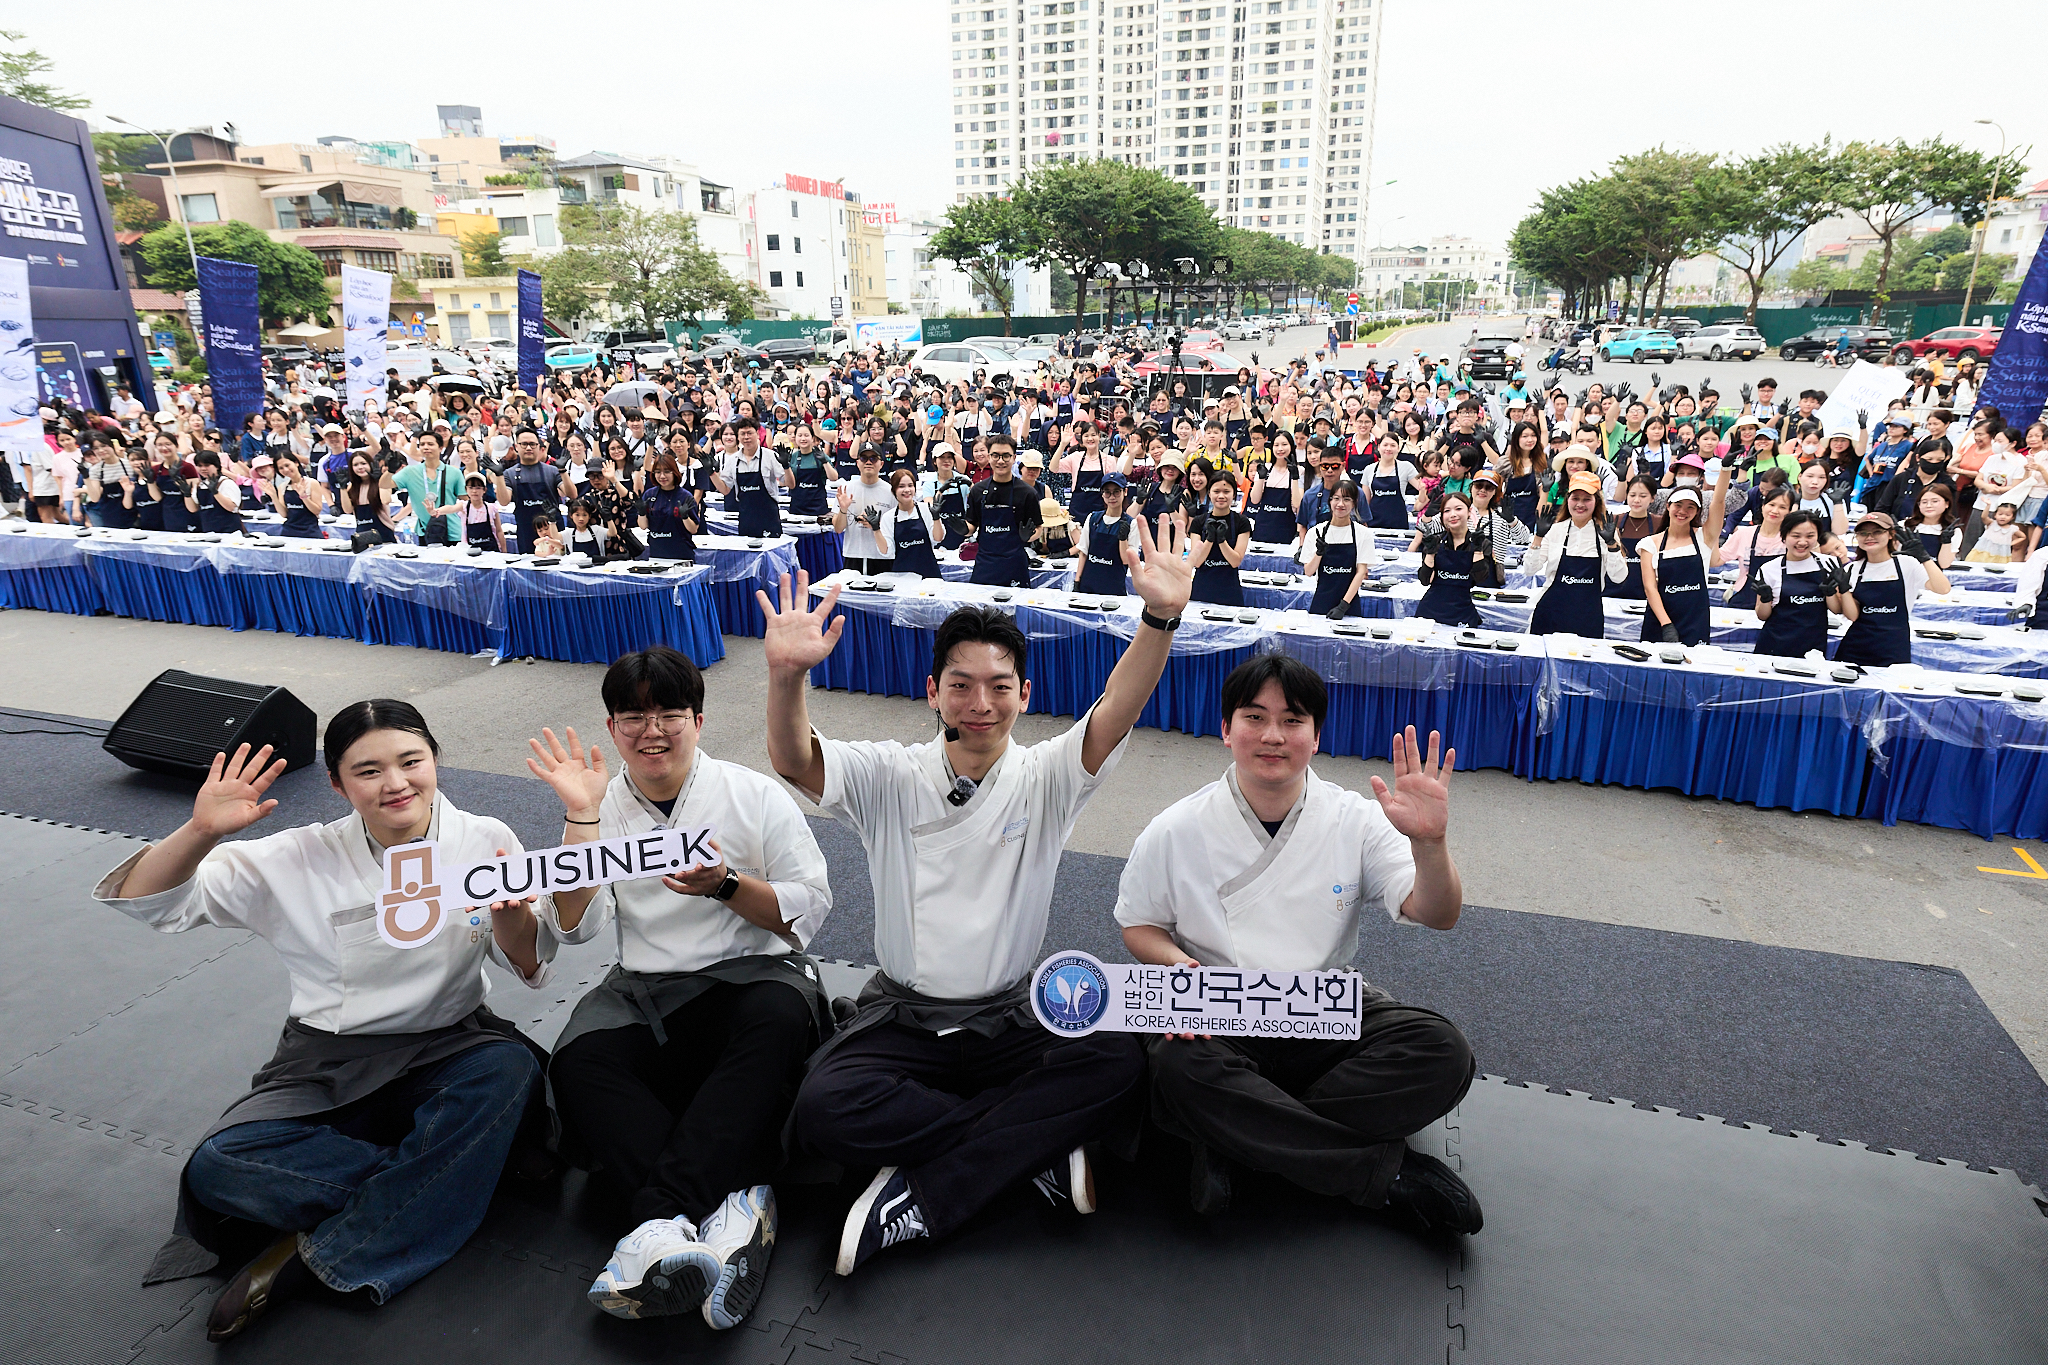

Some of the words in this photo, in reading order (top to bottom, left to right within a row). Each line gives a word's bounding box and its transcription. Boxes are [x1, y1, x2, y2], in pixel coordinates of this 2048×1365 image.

[785, 173, 818, 195] ROMEO
[820, 180, 846, 200] HOTEL
[985, 525, 1010, 533] K-Seafood
[899, 539, 924, 548] K-Seafood
[1089, 554, 1112, 565] K-Seafood
[1323, 566, 1352, 574] K-Seafood
[1438, 570, 1469, 580] K-Seafood
[1561, 575, 1593, 584] K-Seafood
[1665, 584, 1700, 593] K-Seafood
[1790, 596, 1824, 604] K-Seafoo
[464, 829, 714, 899] CUISINE.K
[1040, 969, 1053, 987] KOREA
[1052, 959, 1077, 970] FISHERIES
[1078, 960, 1106, 990] ASSOCIATION
[1124, 969, 1165, 989] 사단
[1170, 968, 1357, 1018] 한국수산회
[1125, 990, 1163, 1011] 법인
[1125, 1014, 1176, 1029] KOREA
[1181, 1016, 1247, 1031] FISHERIES
[1251, 1019, 1356, 1035] ASSOCIATION
